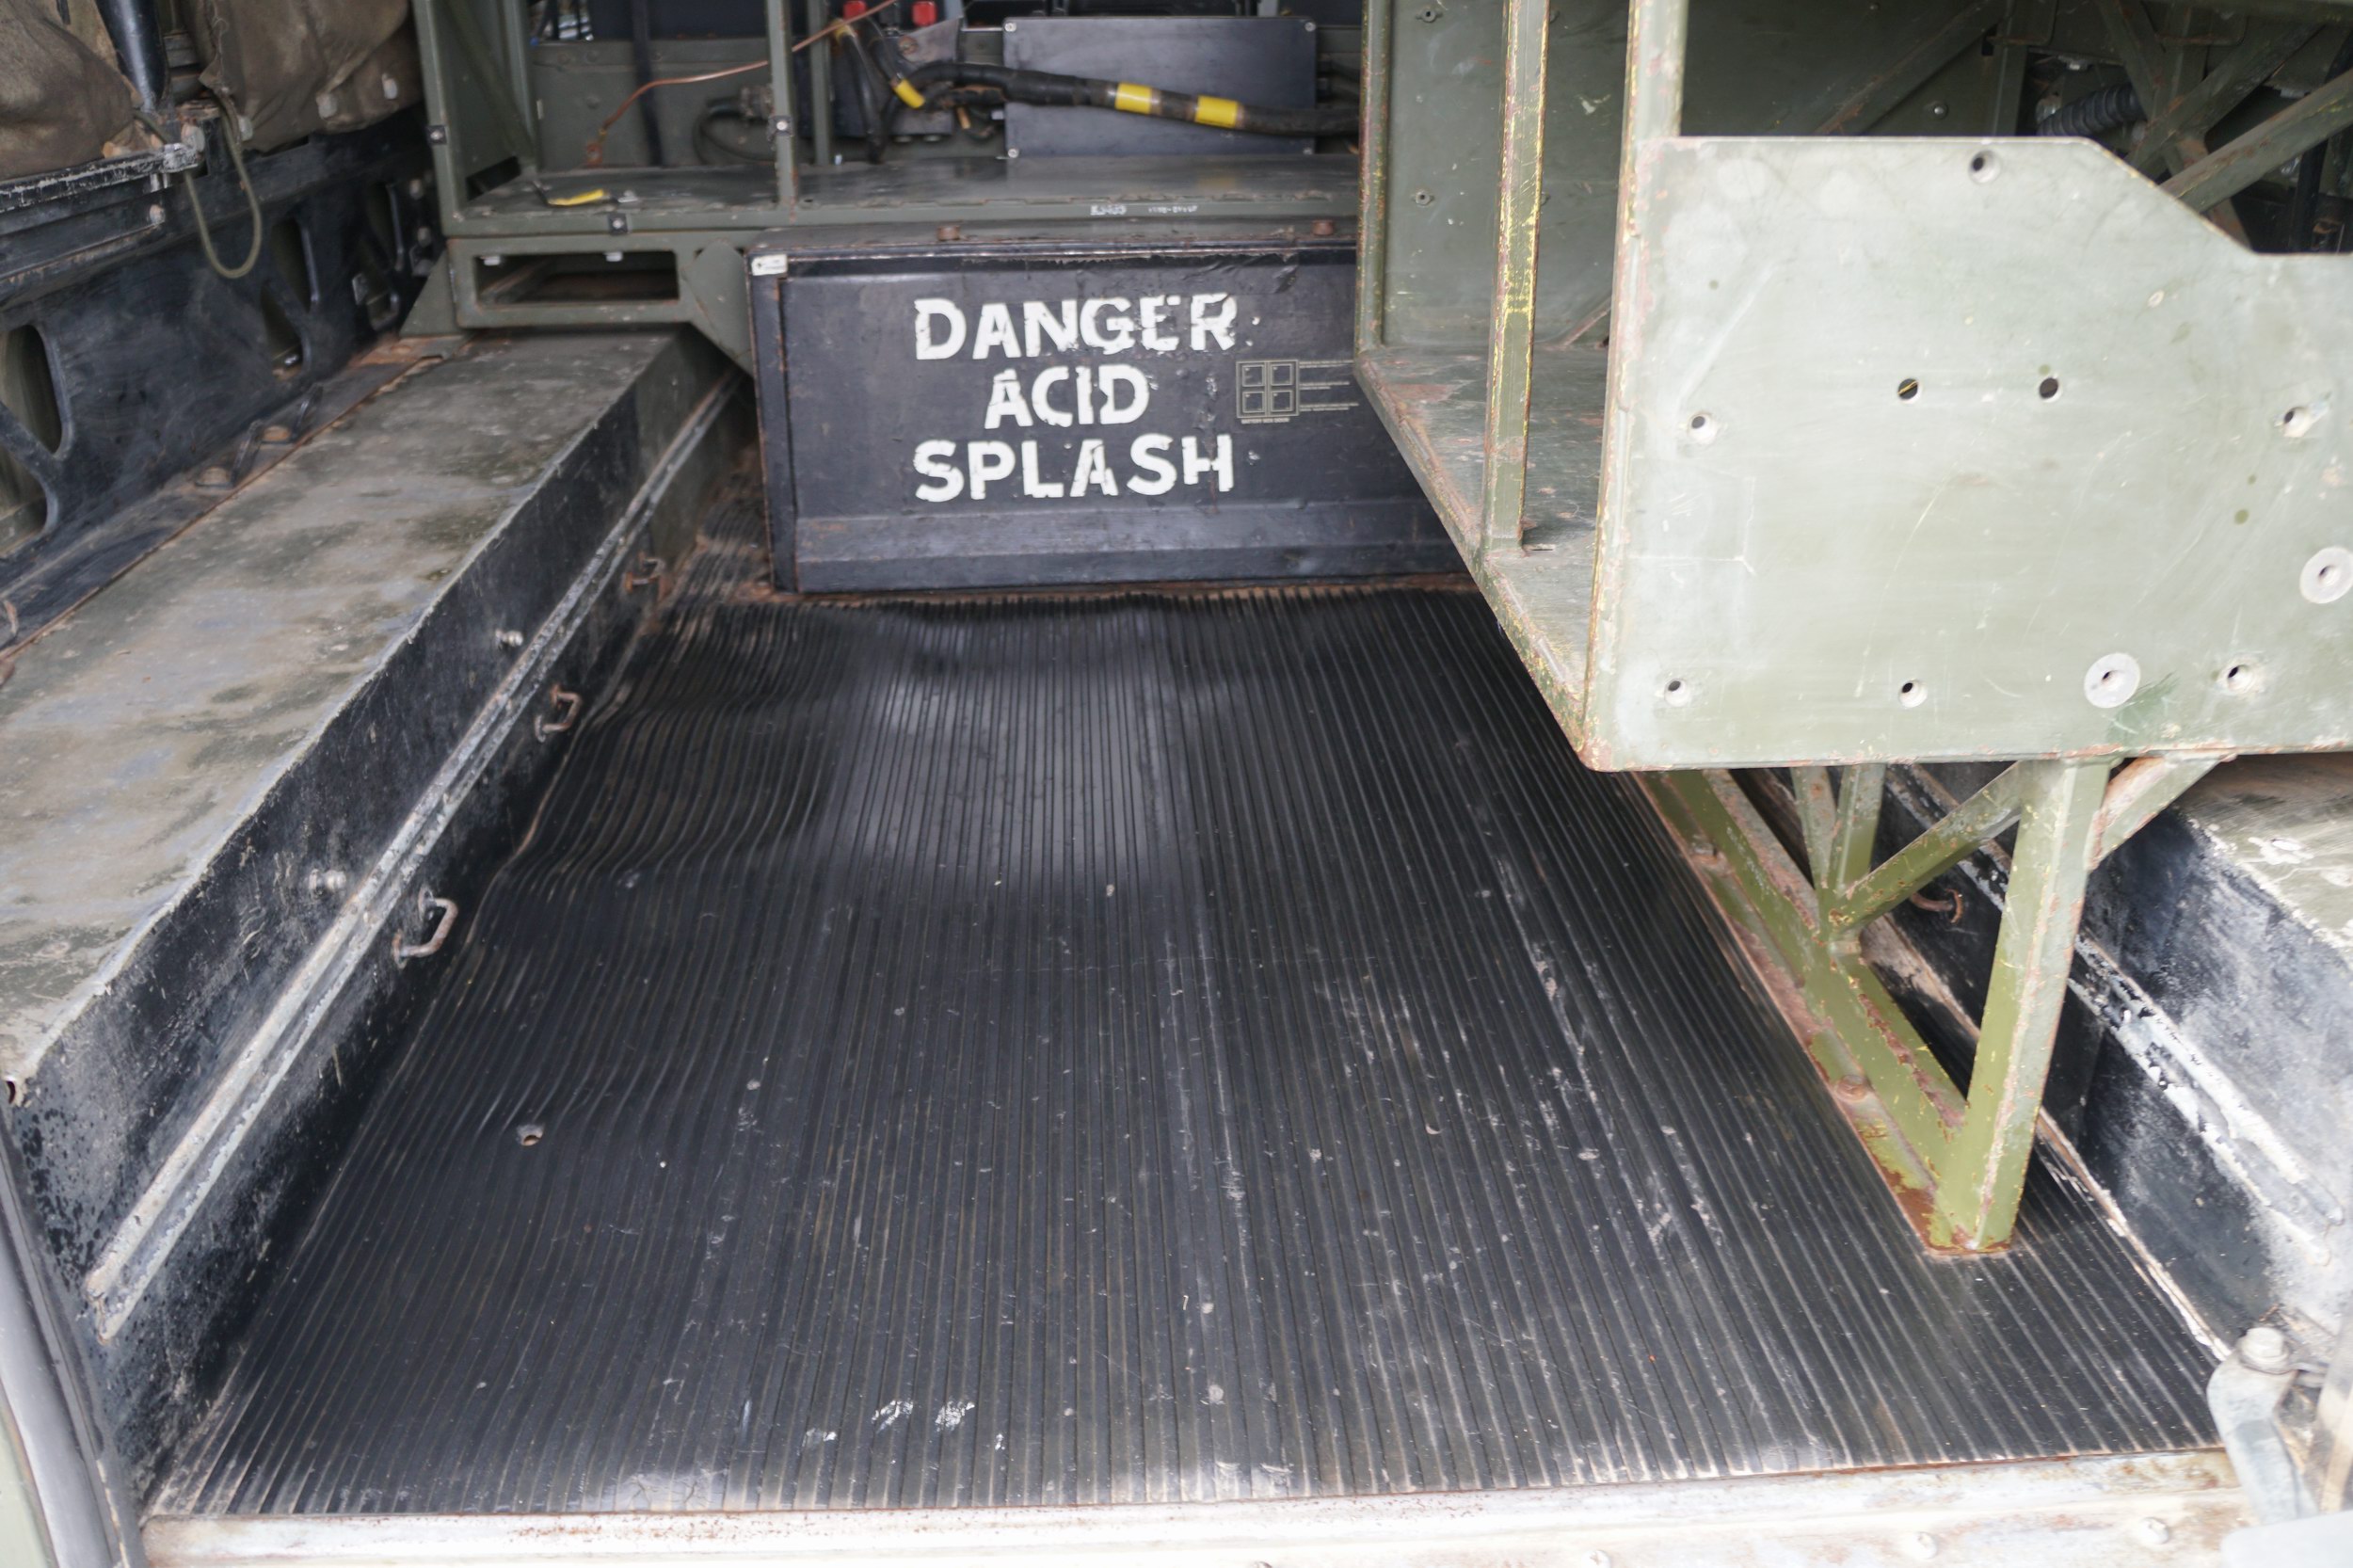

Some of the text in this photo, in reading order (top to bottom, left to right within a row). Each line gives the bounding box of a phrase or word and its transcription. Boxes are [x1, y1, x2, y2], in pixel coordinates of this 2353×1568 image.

[913, 293, 1238, 360] DANGER
[984, 364, 1150, 430] ACID
[913, 434, 1234, 503] SPLASH
